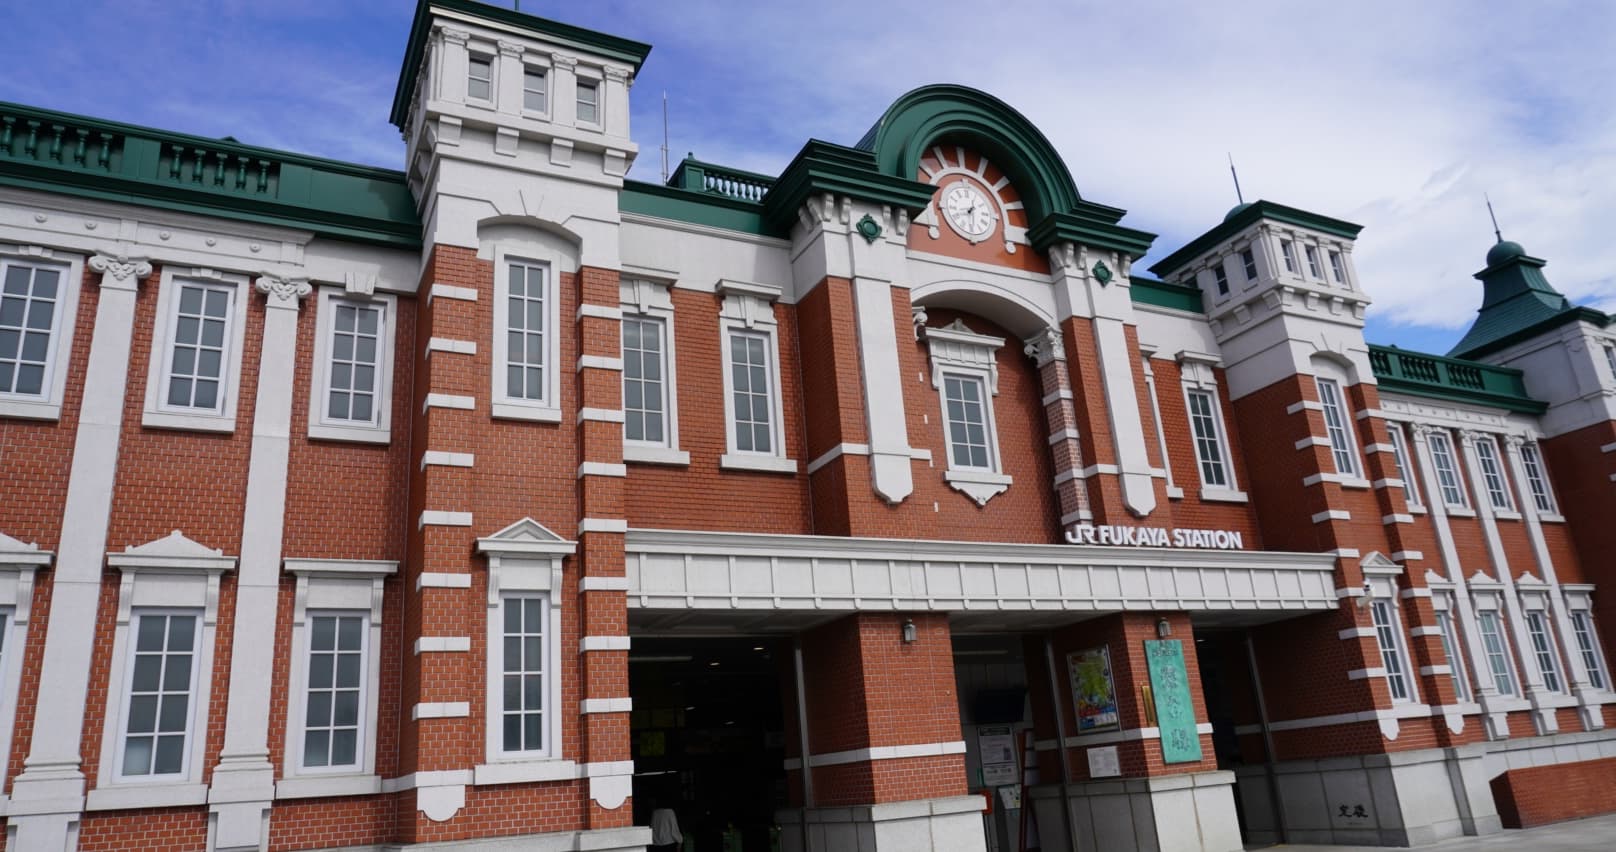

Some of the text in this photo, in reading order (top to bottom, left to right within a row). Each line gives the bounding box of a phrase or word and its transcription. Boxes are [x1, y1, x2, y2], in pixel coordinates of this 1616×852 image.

[1065, 524, 1243, 549] JR FUKAYA STATION
